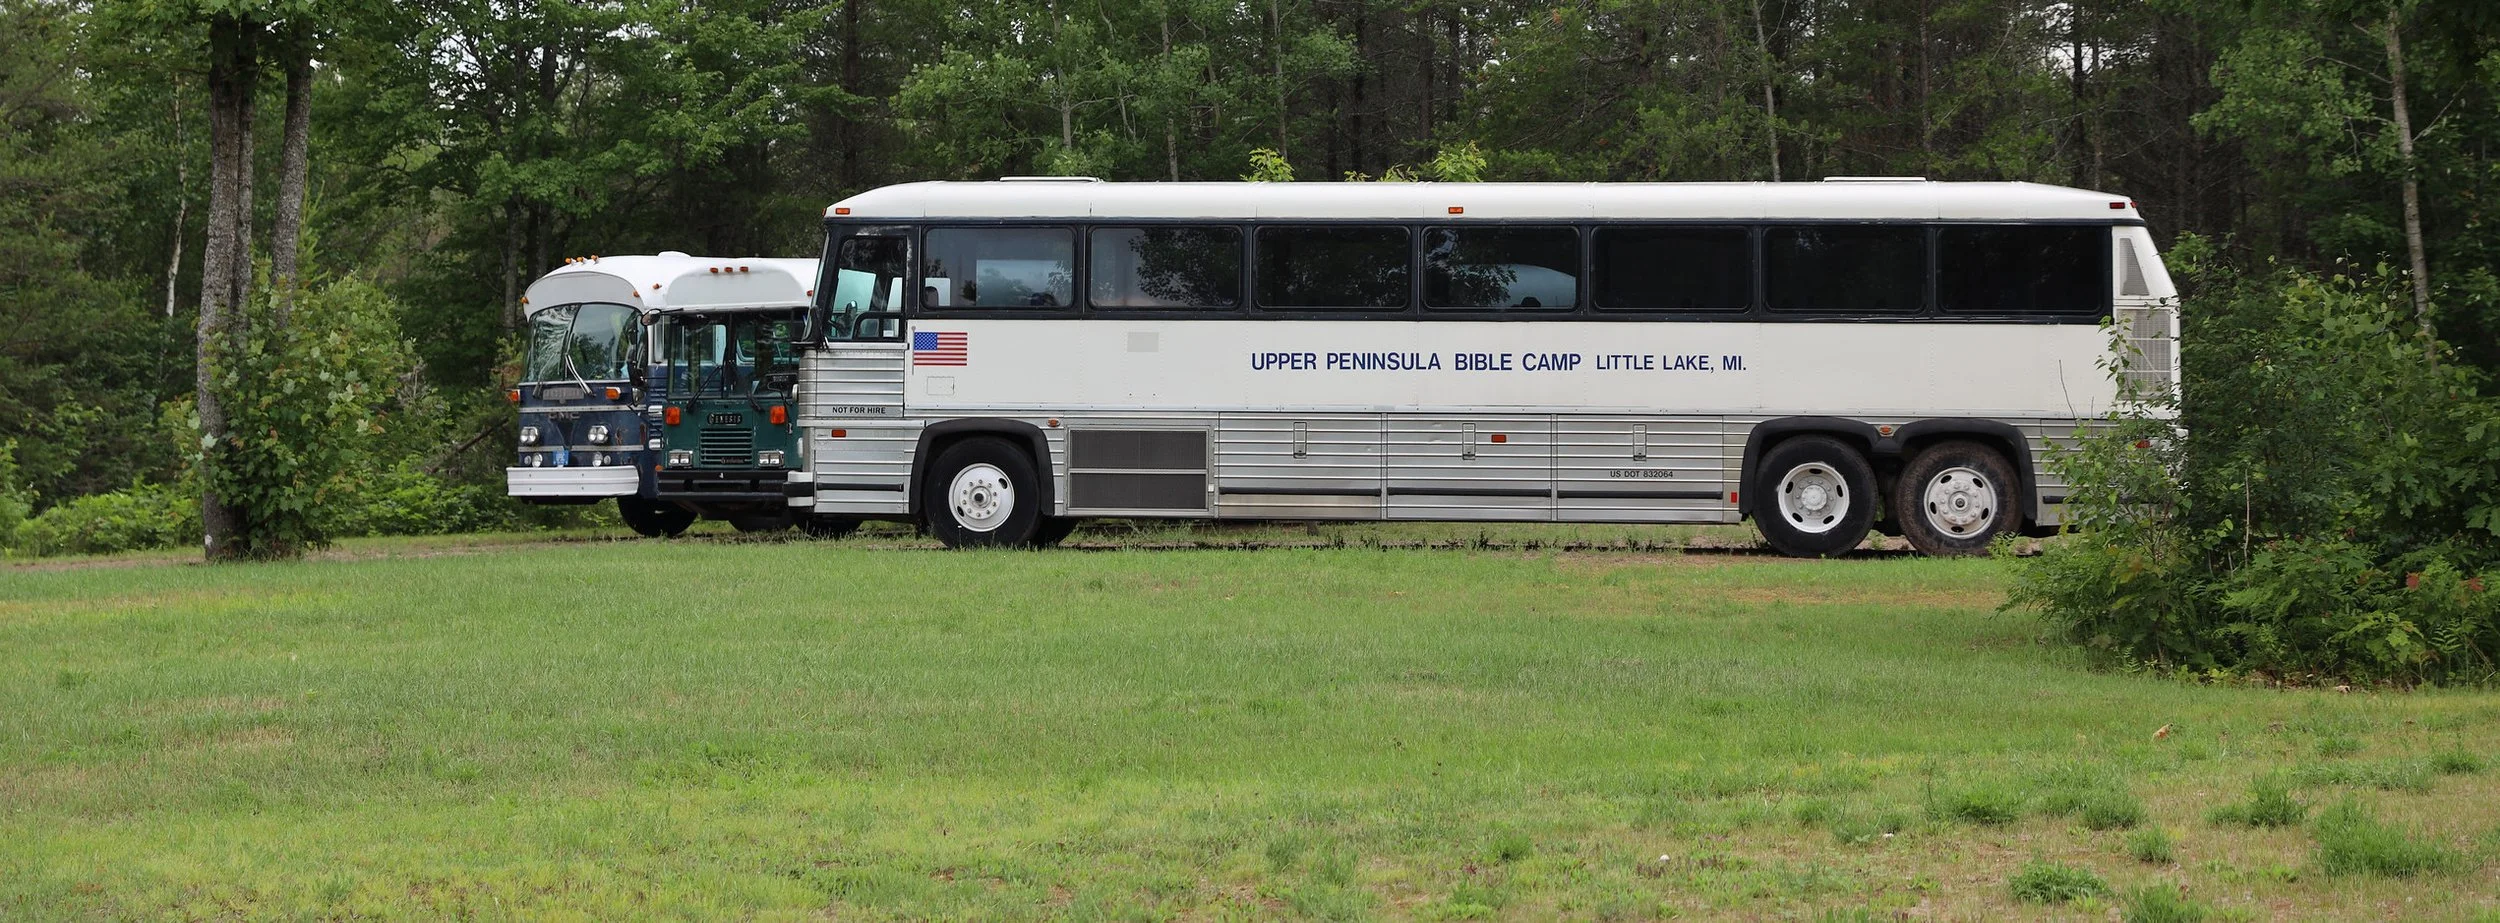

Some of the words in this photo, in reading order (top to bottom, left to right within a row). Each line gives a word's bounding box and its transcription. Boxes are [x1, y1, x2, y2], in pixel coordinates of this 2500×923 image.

[1251, 352, 1317, 371] UPPER
[1326, 352, 1441, 371] PENINSULA
[1454, 353, 1513, 371] BIBLE
[1521, 353, 1582, 371] CAMP
[1596, 354, 1655, 371] LITTLE
[1662, 354, 1715, 374] LAKE,
[1722, 355, 1747, 371] MI.
[832, 406, 848, 414] NOT
[849, 406, 866, 414] FOR
[867, 406, 887, 414] HIRE
[1610, 470, 1621, 478] US
[1624, 470, 1640, 478] DOT
[1643, 470, 1674, 478] 832064
